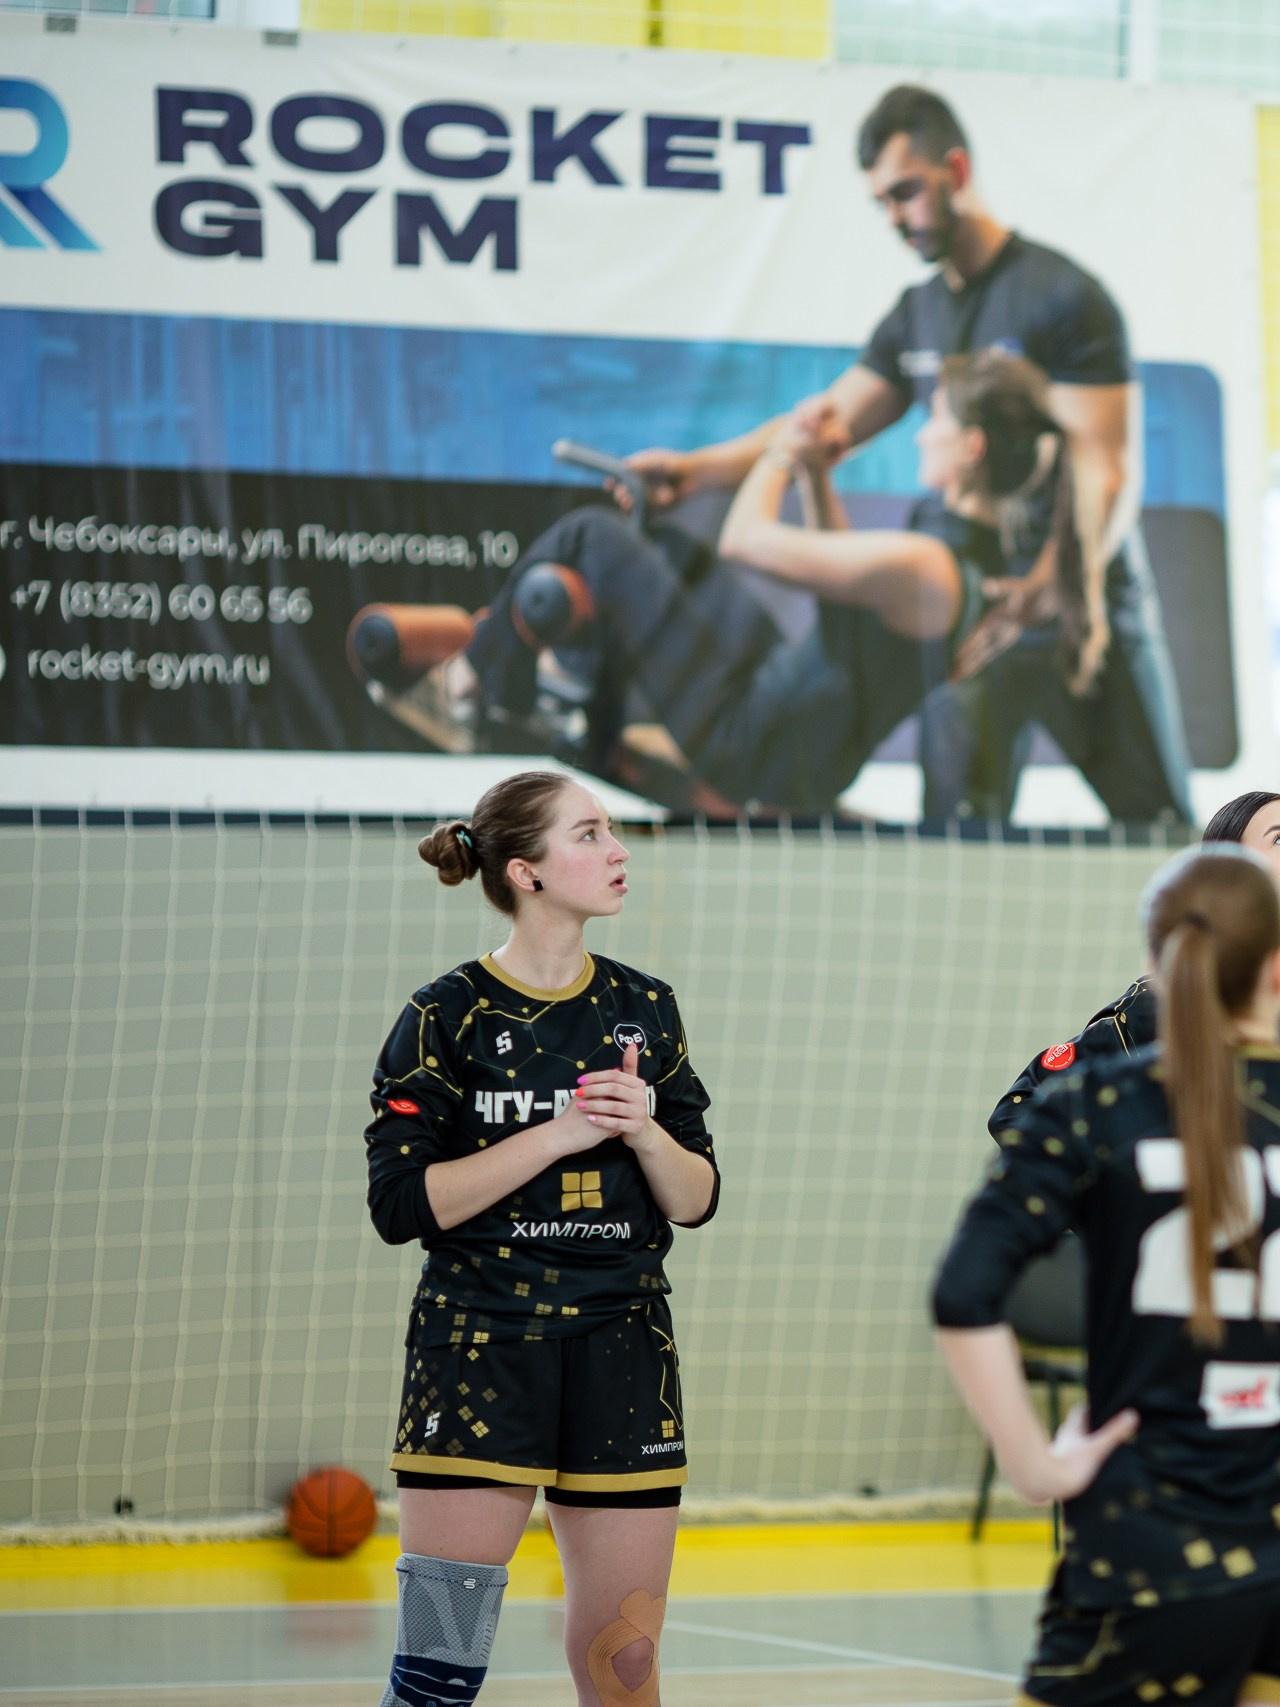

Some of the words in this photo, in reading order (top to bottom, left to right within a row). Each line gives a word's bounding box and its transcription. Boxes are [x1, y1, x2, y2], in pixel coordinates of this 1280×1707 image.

[155, 85, 813, 196] ROCKET
[153, 178, 519, 272] GYM
[29, 514, 238, 563] Чебоксары,
[241, 527, 293, 565] ул.
[298, 523, 476, 571] Пирогова,
[478, 529, 519, 568] 10
[10, 579, 51, 616] +7
[60, 578, 162, 626] (8352)
[168, 583, 216, 622] 60
[220, 584, 264, 623] 65
[268, 585, 313, 625] 56
[28, 643, 271, 690] rocket-gym.ru
[618, 1032, 643, 1045] РФБ
[511, 1221, 632, 1240] ХИМПРОМ
[641, 1440, 684, 1455] ХИМПРОМ
